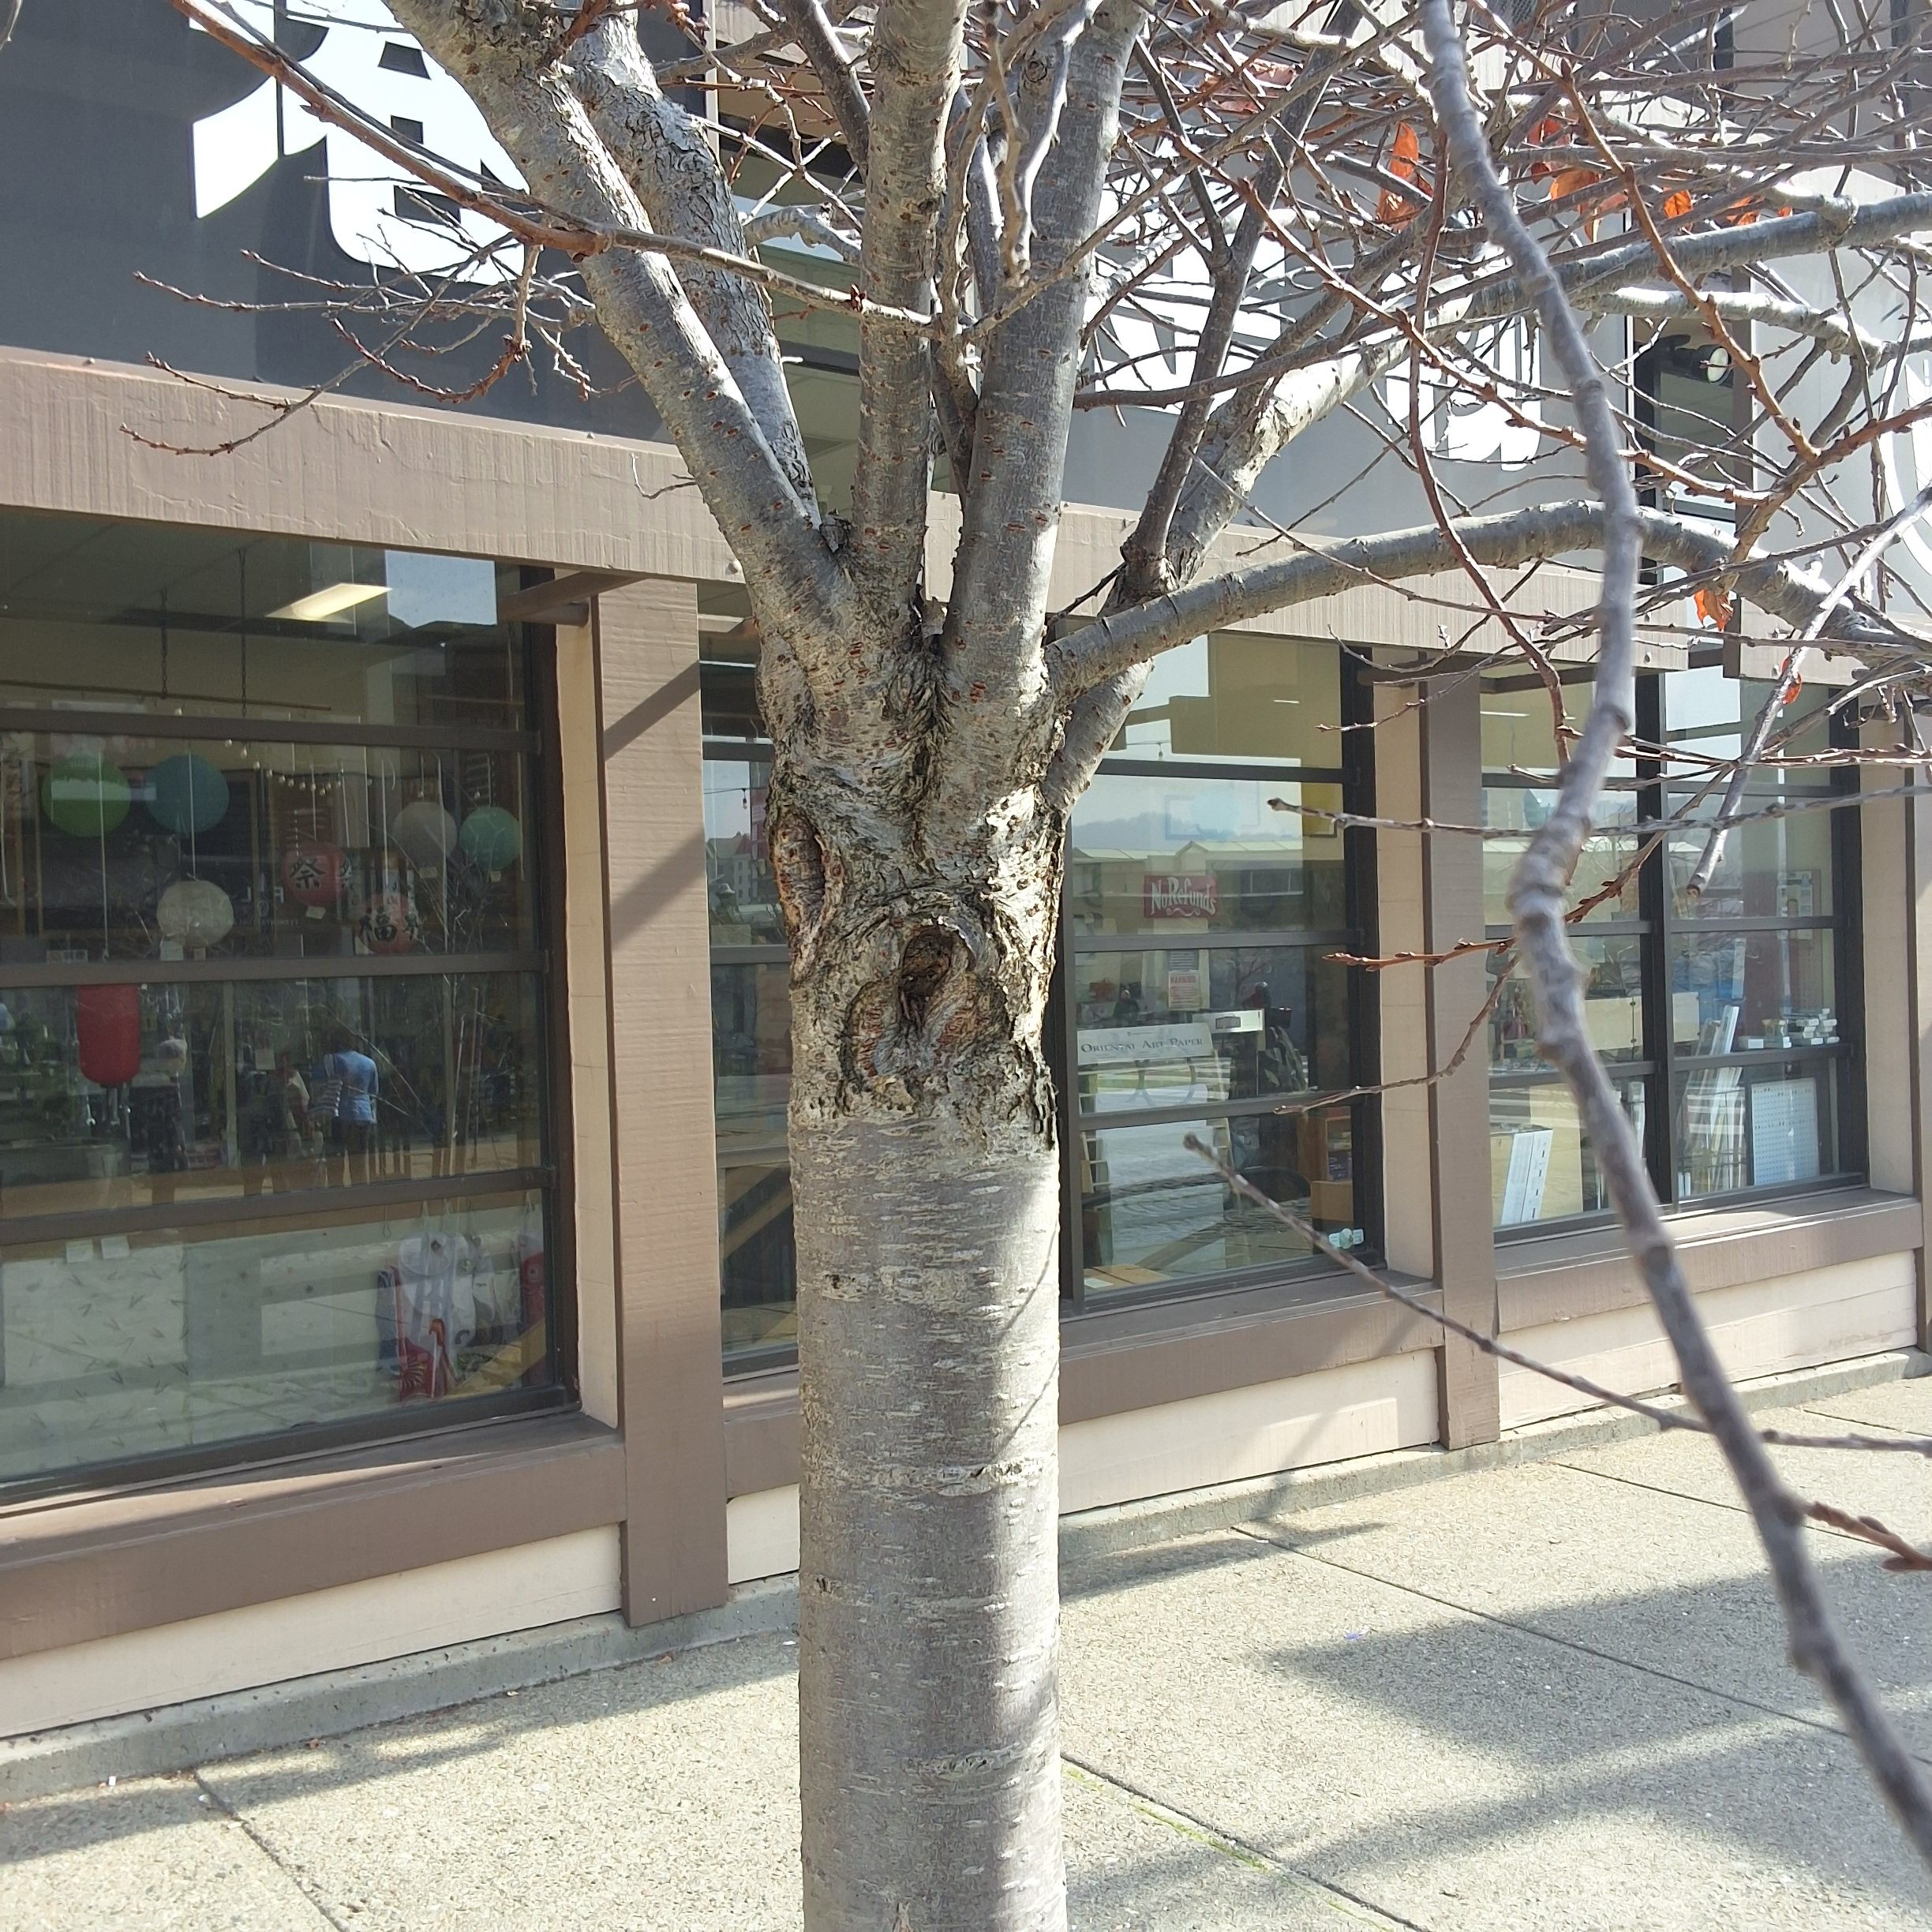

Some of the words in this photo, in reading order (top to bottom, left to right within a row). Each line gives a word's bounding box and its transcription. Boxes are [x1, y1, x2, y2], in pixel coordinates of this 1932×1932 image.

[1150, 878, 1167, 915] No
[1166, 876, 1217, 915] Refunds
[1142, 1040, 1164, 1049] ART
[1170, 1037, 1204, 1047] PAPER
